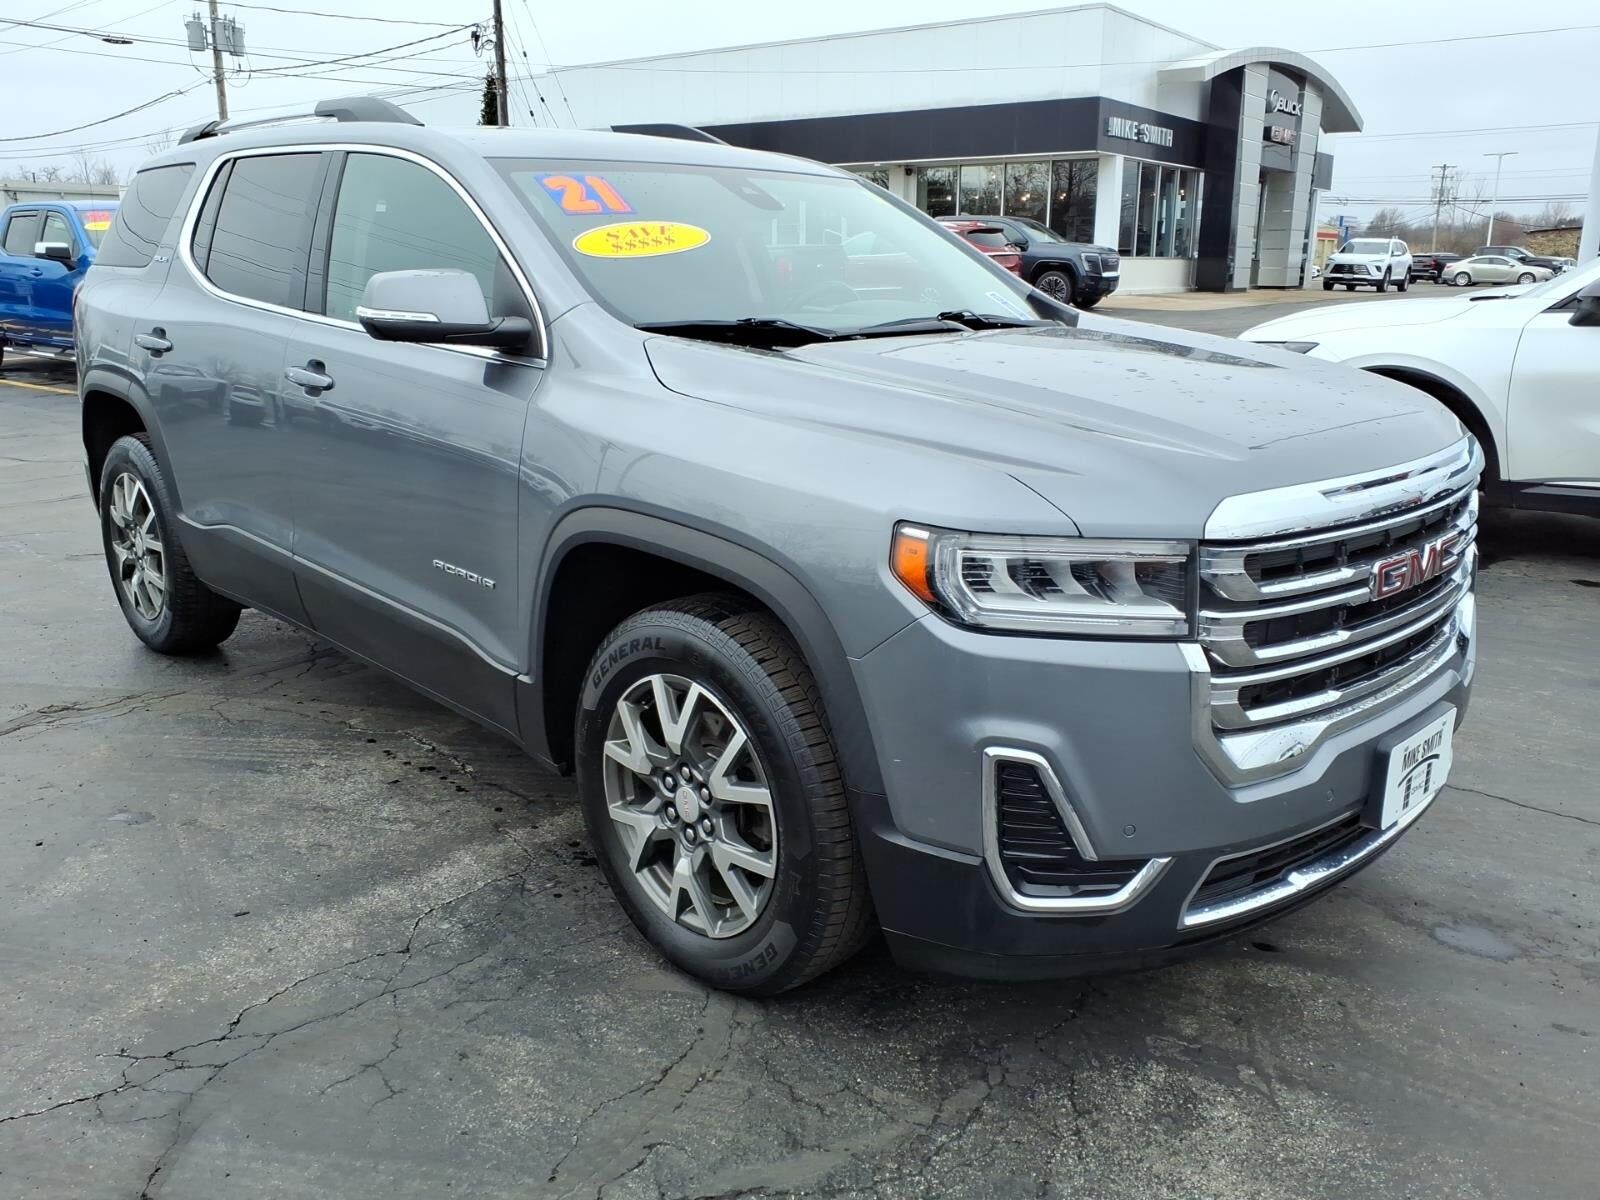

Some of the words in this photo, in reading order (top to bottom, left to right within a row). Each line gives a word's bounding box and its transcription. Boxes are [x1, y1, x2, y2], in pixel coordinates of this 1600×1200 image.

[1278, 97, 1301, 116] BUICK
[1108, 117, 1138, 140] MIKE
[1143, 123, 1173, 147] SMITH
[1271, 125, 1297, 145] GMC
[543, 175, 632, 212] 21
[433, 559, 496, 590] ACADIA
[1369, 530, 1461, 601] GMC
[593, 636, 666, 689] GENERAL
[1402, 743, 1421, 773] MIKE
[1422, 730, 1443, 760] SMITH
[717, 942, 778, 980] GENE
